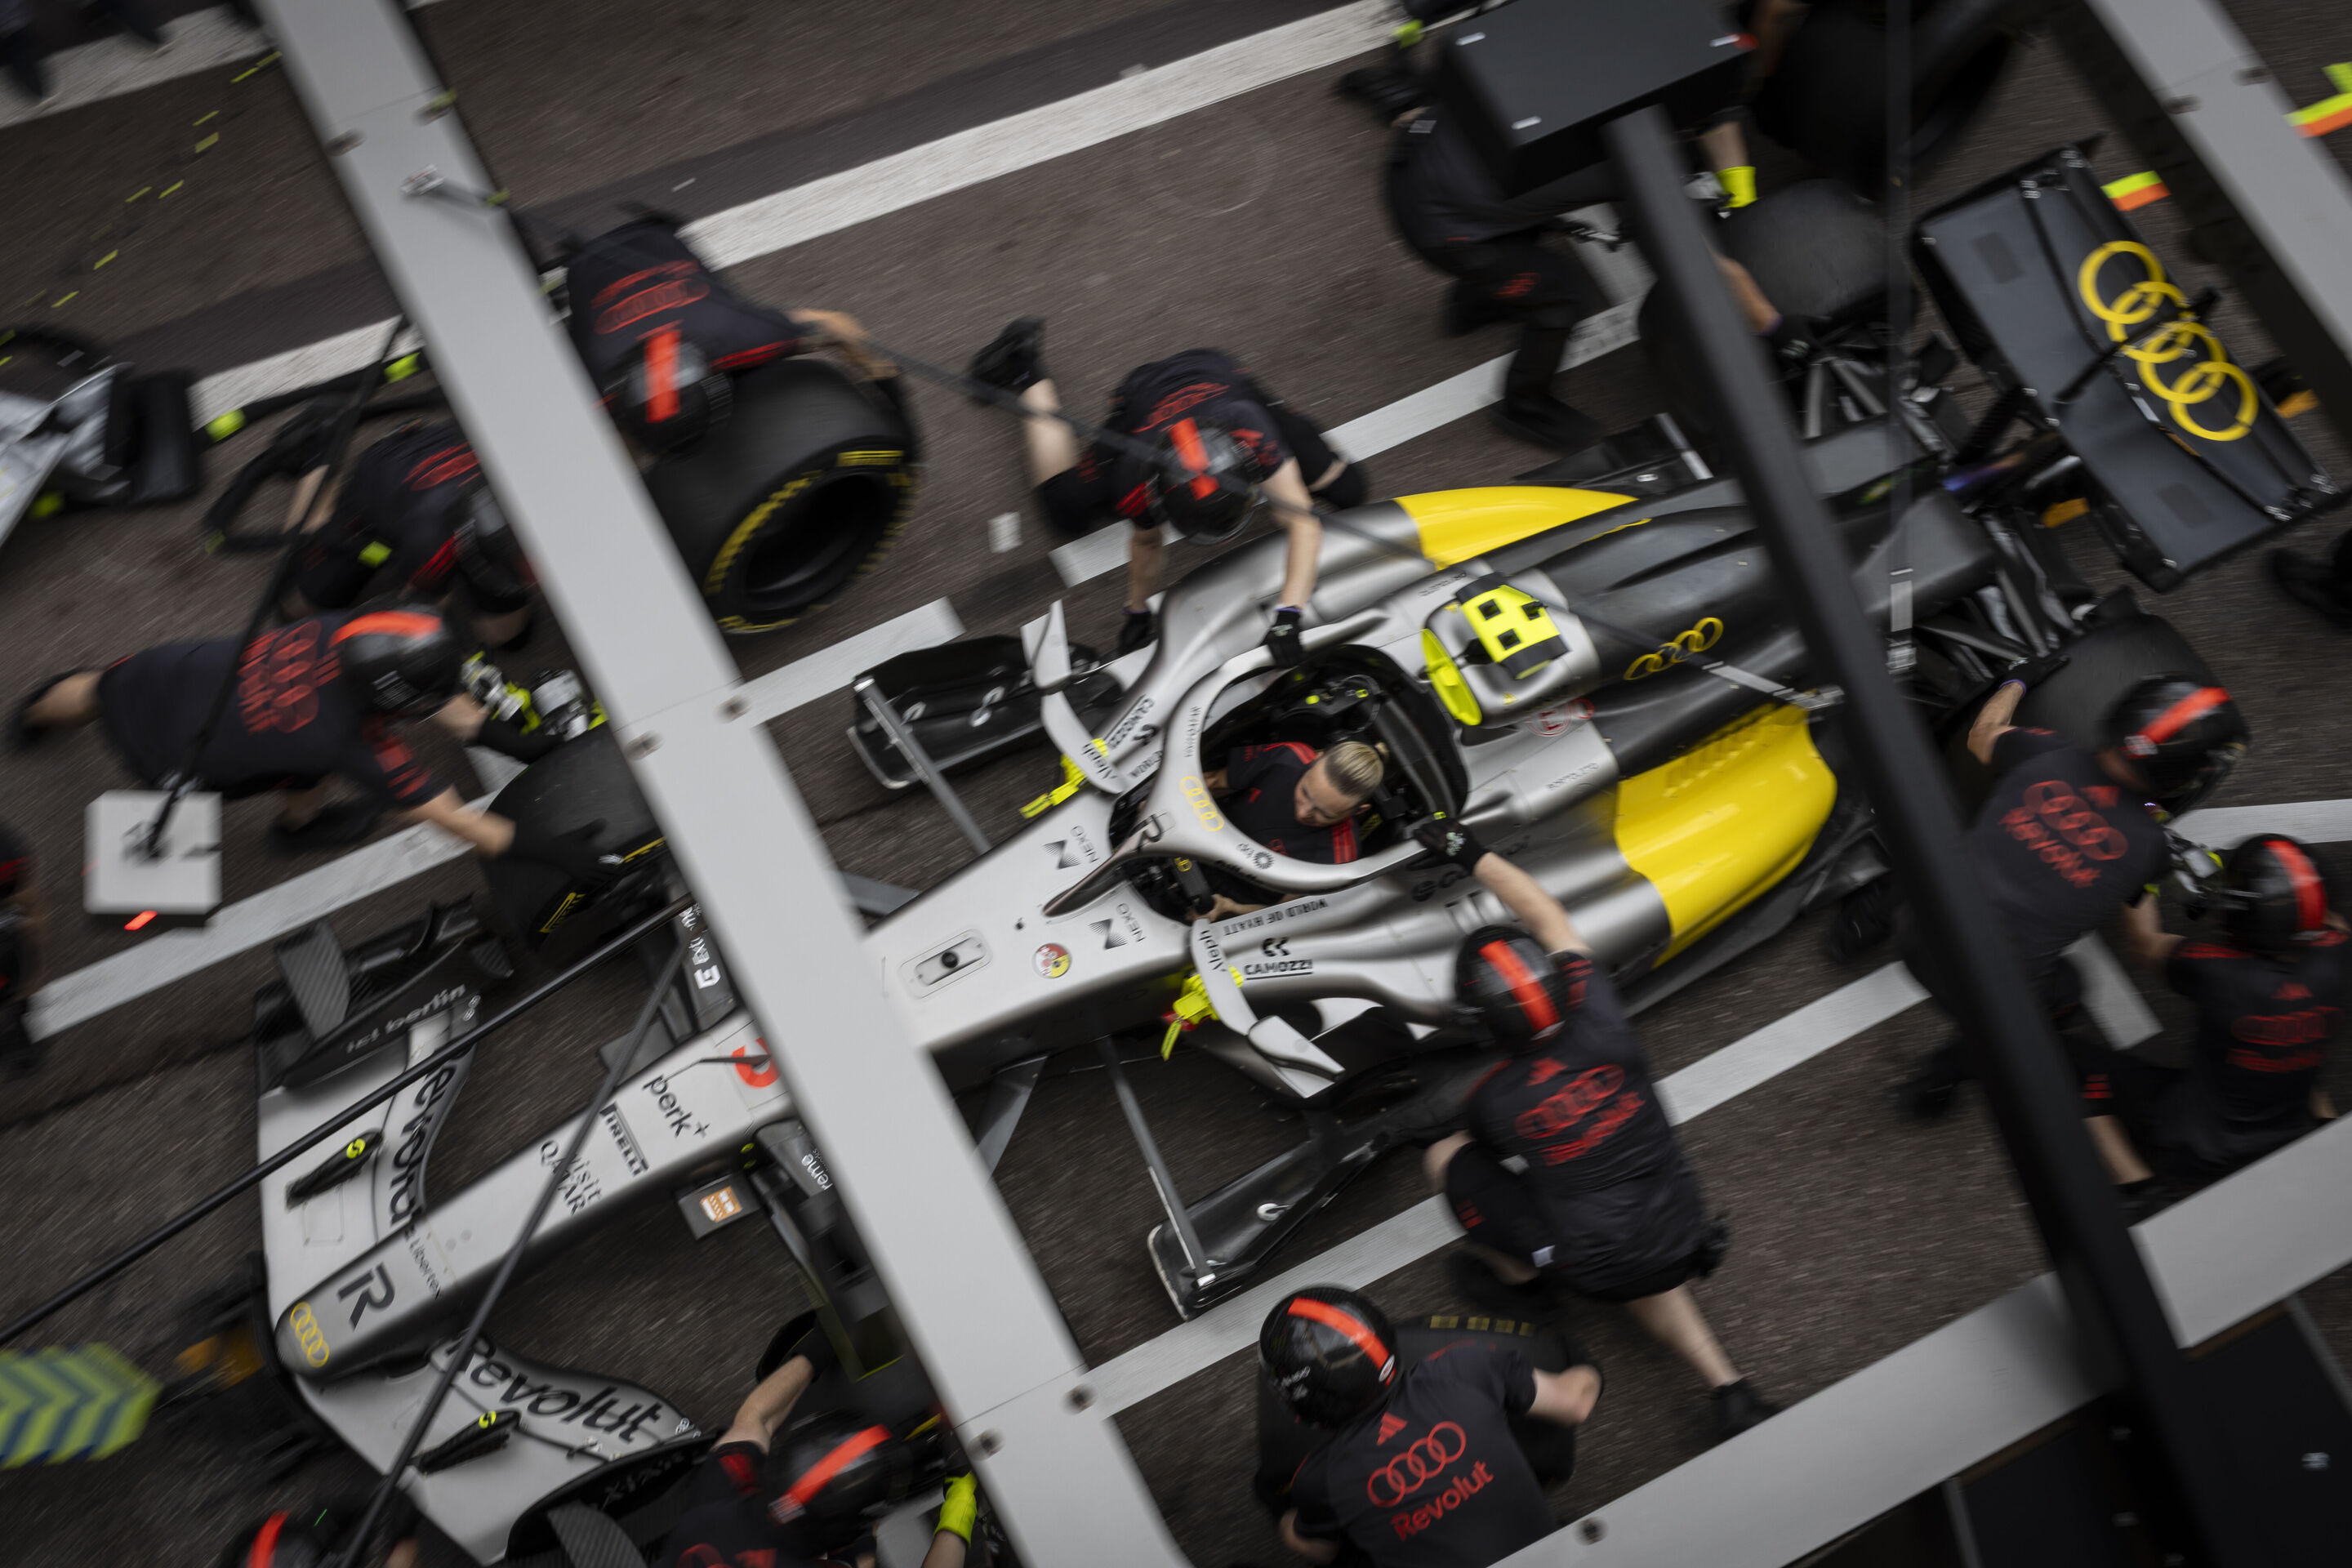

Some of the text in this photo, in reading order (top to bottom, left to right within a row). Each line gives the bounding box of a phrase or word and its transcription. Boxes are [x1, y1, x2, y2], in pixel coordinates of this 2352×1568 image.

[1071, 825, 1099, 864] NEXO
[1116, 902, 1146, 942] NEXO
[1198, 929, 1227, 972] Aleph
[1244, 959, 1314, 975] CAMOZZI
[384, 983, 467, 1035] berlin
[599, 1101, 650, 1177] PIRELLI
[1392, 1460, 1494, 1540] Revolut
